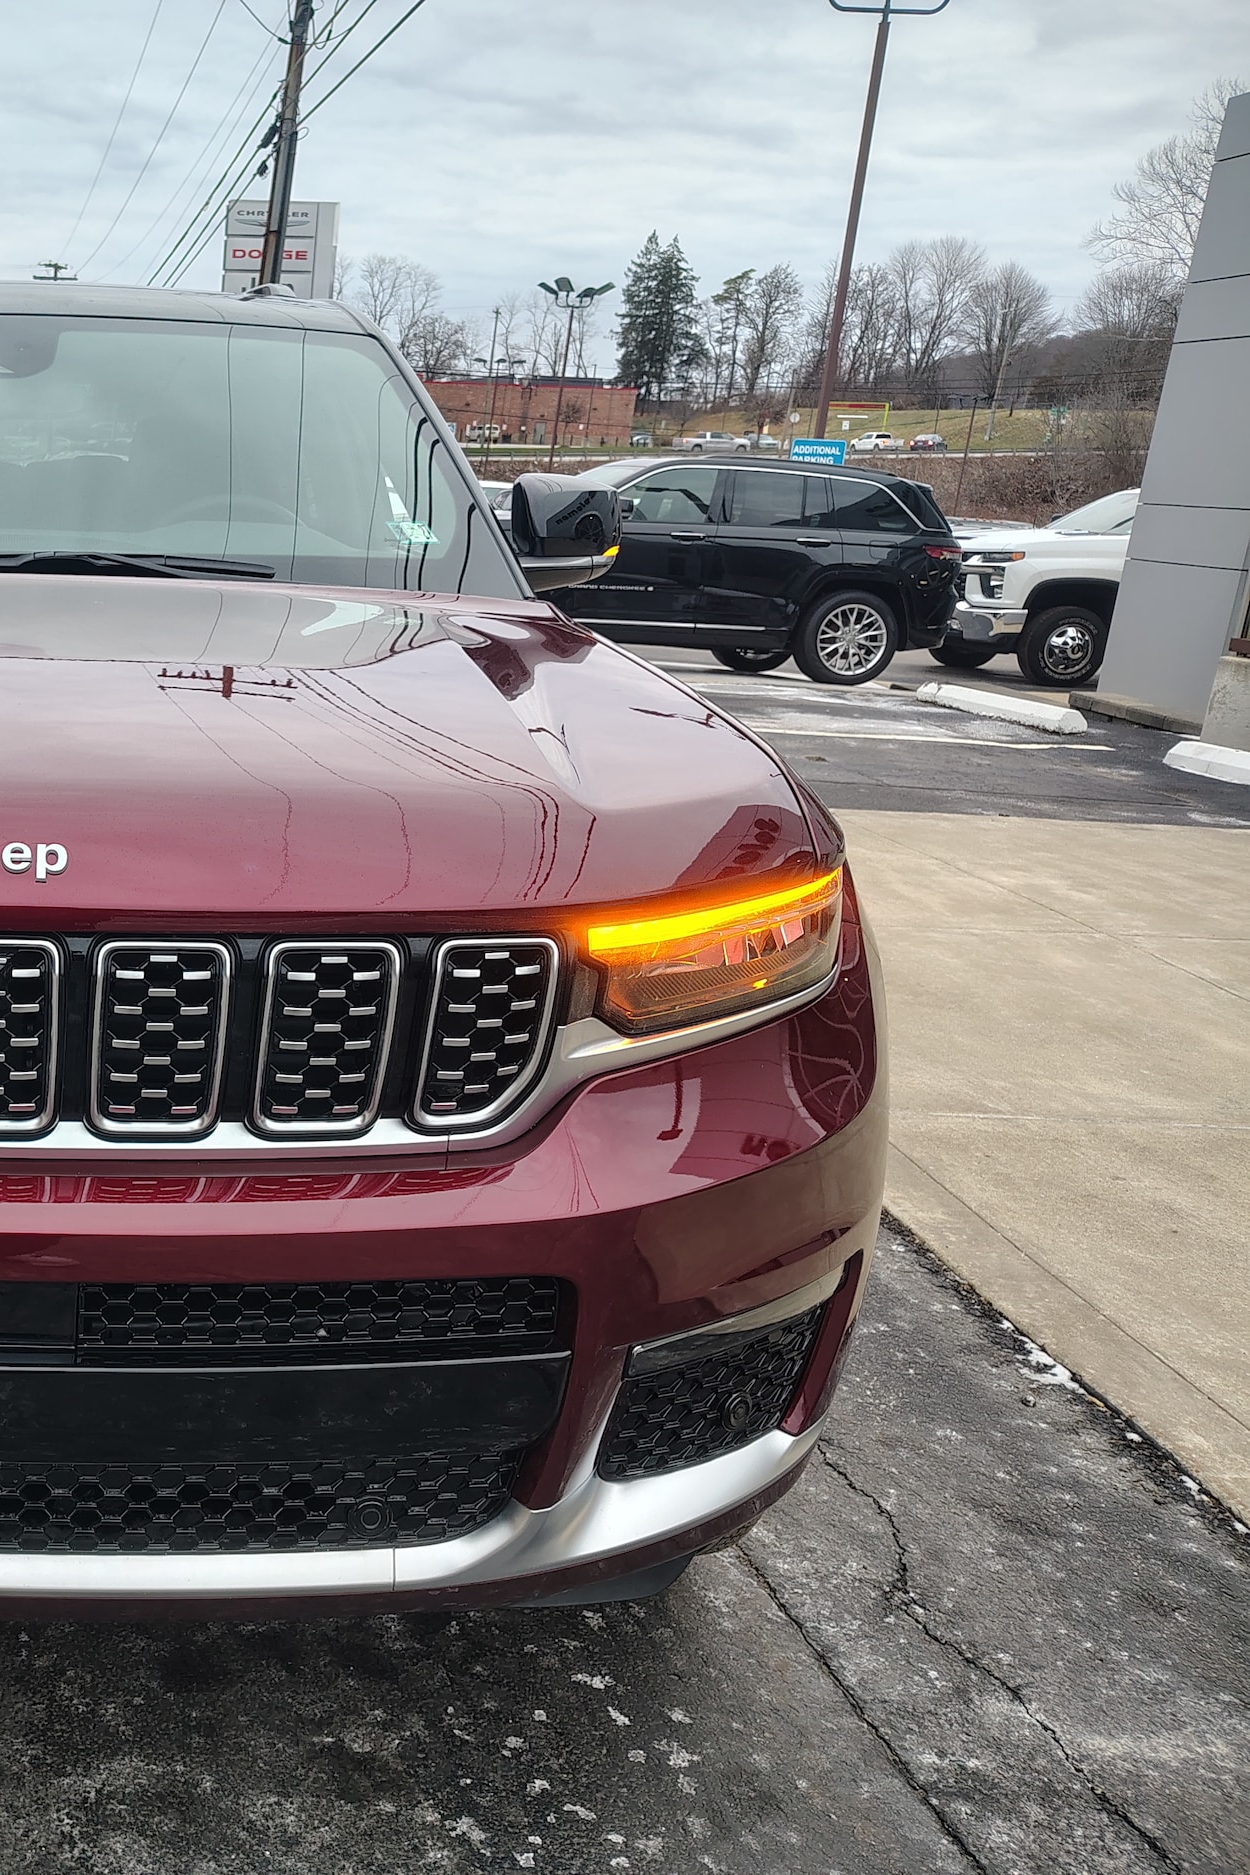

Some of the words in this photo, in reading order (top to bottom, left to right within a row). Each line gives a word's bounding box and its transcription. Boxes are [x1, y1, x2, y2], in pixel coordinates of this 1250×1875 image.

[237, 210, 310, 218] CHRER
[232, 249, 308, 261] DOGE
[793, 445, 841, 455] ADDITIONAL
